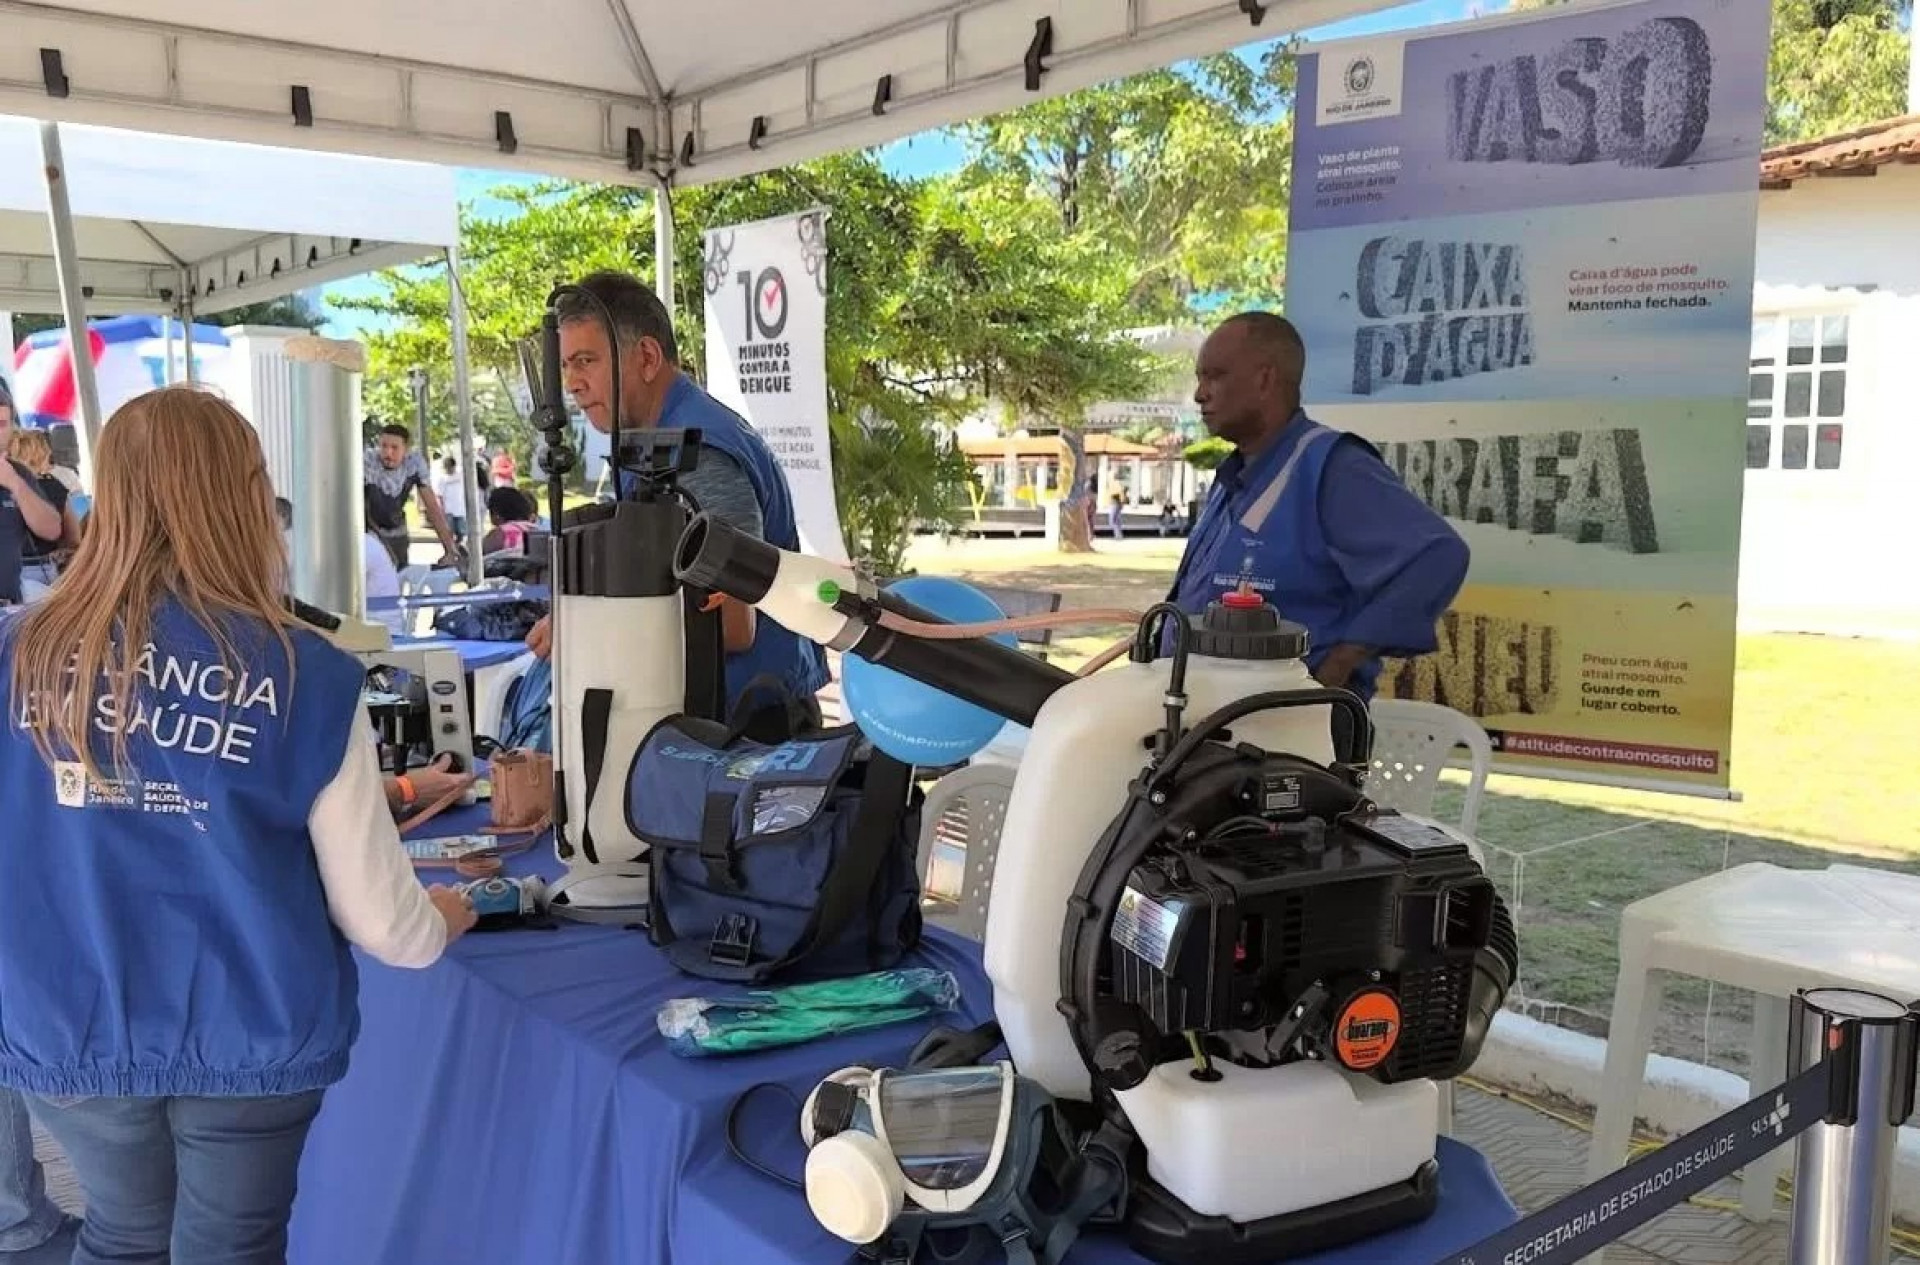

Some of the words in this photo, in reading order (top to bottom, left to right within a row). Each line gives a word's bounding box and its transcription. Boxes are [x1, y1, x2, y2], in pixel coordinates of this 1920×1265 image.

[1446, 17, 1711, 169] VASO
[1318, 153, 1345, 165] Vaso
[1347, 150, 1361, 161] de
[1356, 235, 1529, 318] CAIXA
[1569, 269, 1607, 281] Caixa
[1609, 266, 1658, 280] d'água
[1661, 263, 1698, 278] pode
[1568, 284, 1600, 297] virar
[1602, 283, 1634, 295] foco
[1636, 281, 1653, 293] de
[737, 266, 788, 341] 10
[1568, 298, 1642, 312] Mantenha
[1645, 295, 1712, 309] fechada.
[738, 342, 790, 360] MINUTOS
[739, 361, 778, 375] CONTRA
[782, 360, 790, 373] A
[740, 376, 791, 394] DENGUE
[1377, 428, 1660, 553] RRAFA
[1377, 609, 1562, 717] NEU
[1582, 653, 1618, 666] Pneu
[1620, 657, 1652, 667] com
[1653, 658, 1688, 671] água
[1581, 682, 1634, 696] Guarde
[1637, 688, 1660, 698] em
[1581, 697, 1618, 711] lugar
[1620, 701, 1681, 715] coberto.
[94, 693, 257, 764] SAÚDE
[1506, 738, 1714, 770] #atitudecontraomosquito
[1503, 1209, 1597, 1265] SECRETARIA
[1600, 1197, 1619, 1222] DE
[1620, 1167, 1674, 1210] ESTADO
[1674, 1156, 1693, 1180] DE
[1694, 1133, 1735, 1169] SAÚDE
